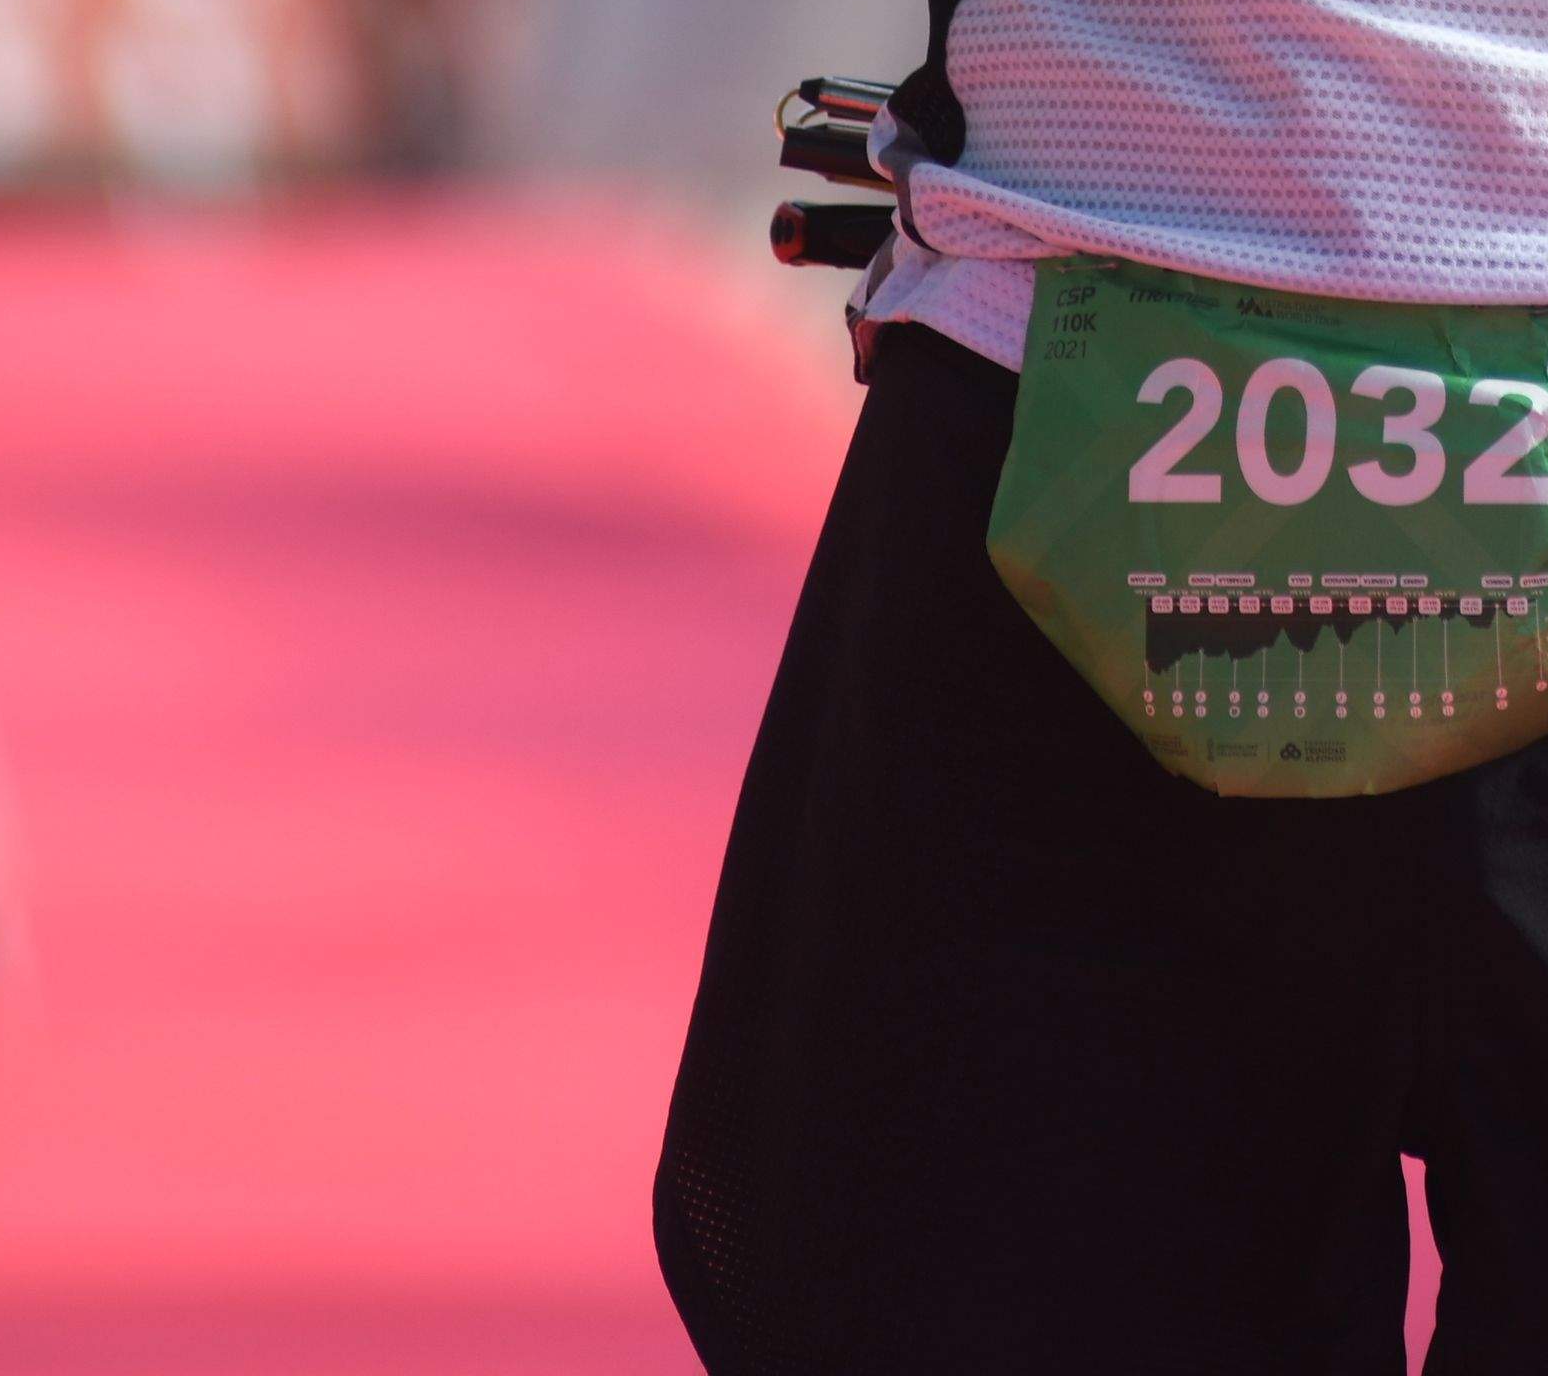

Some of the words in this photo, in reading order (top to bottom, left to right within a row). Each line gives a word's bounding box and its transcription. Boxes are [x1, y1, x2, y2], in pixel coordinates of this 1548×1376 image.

[1056, 285, 1097, 308] CSP
[1053, 312, 1097, 334] 110K
[1042, 339, 1088, 361] 2021
